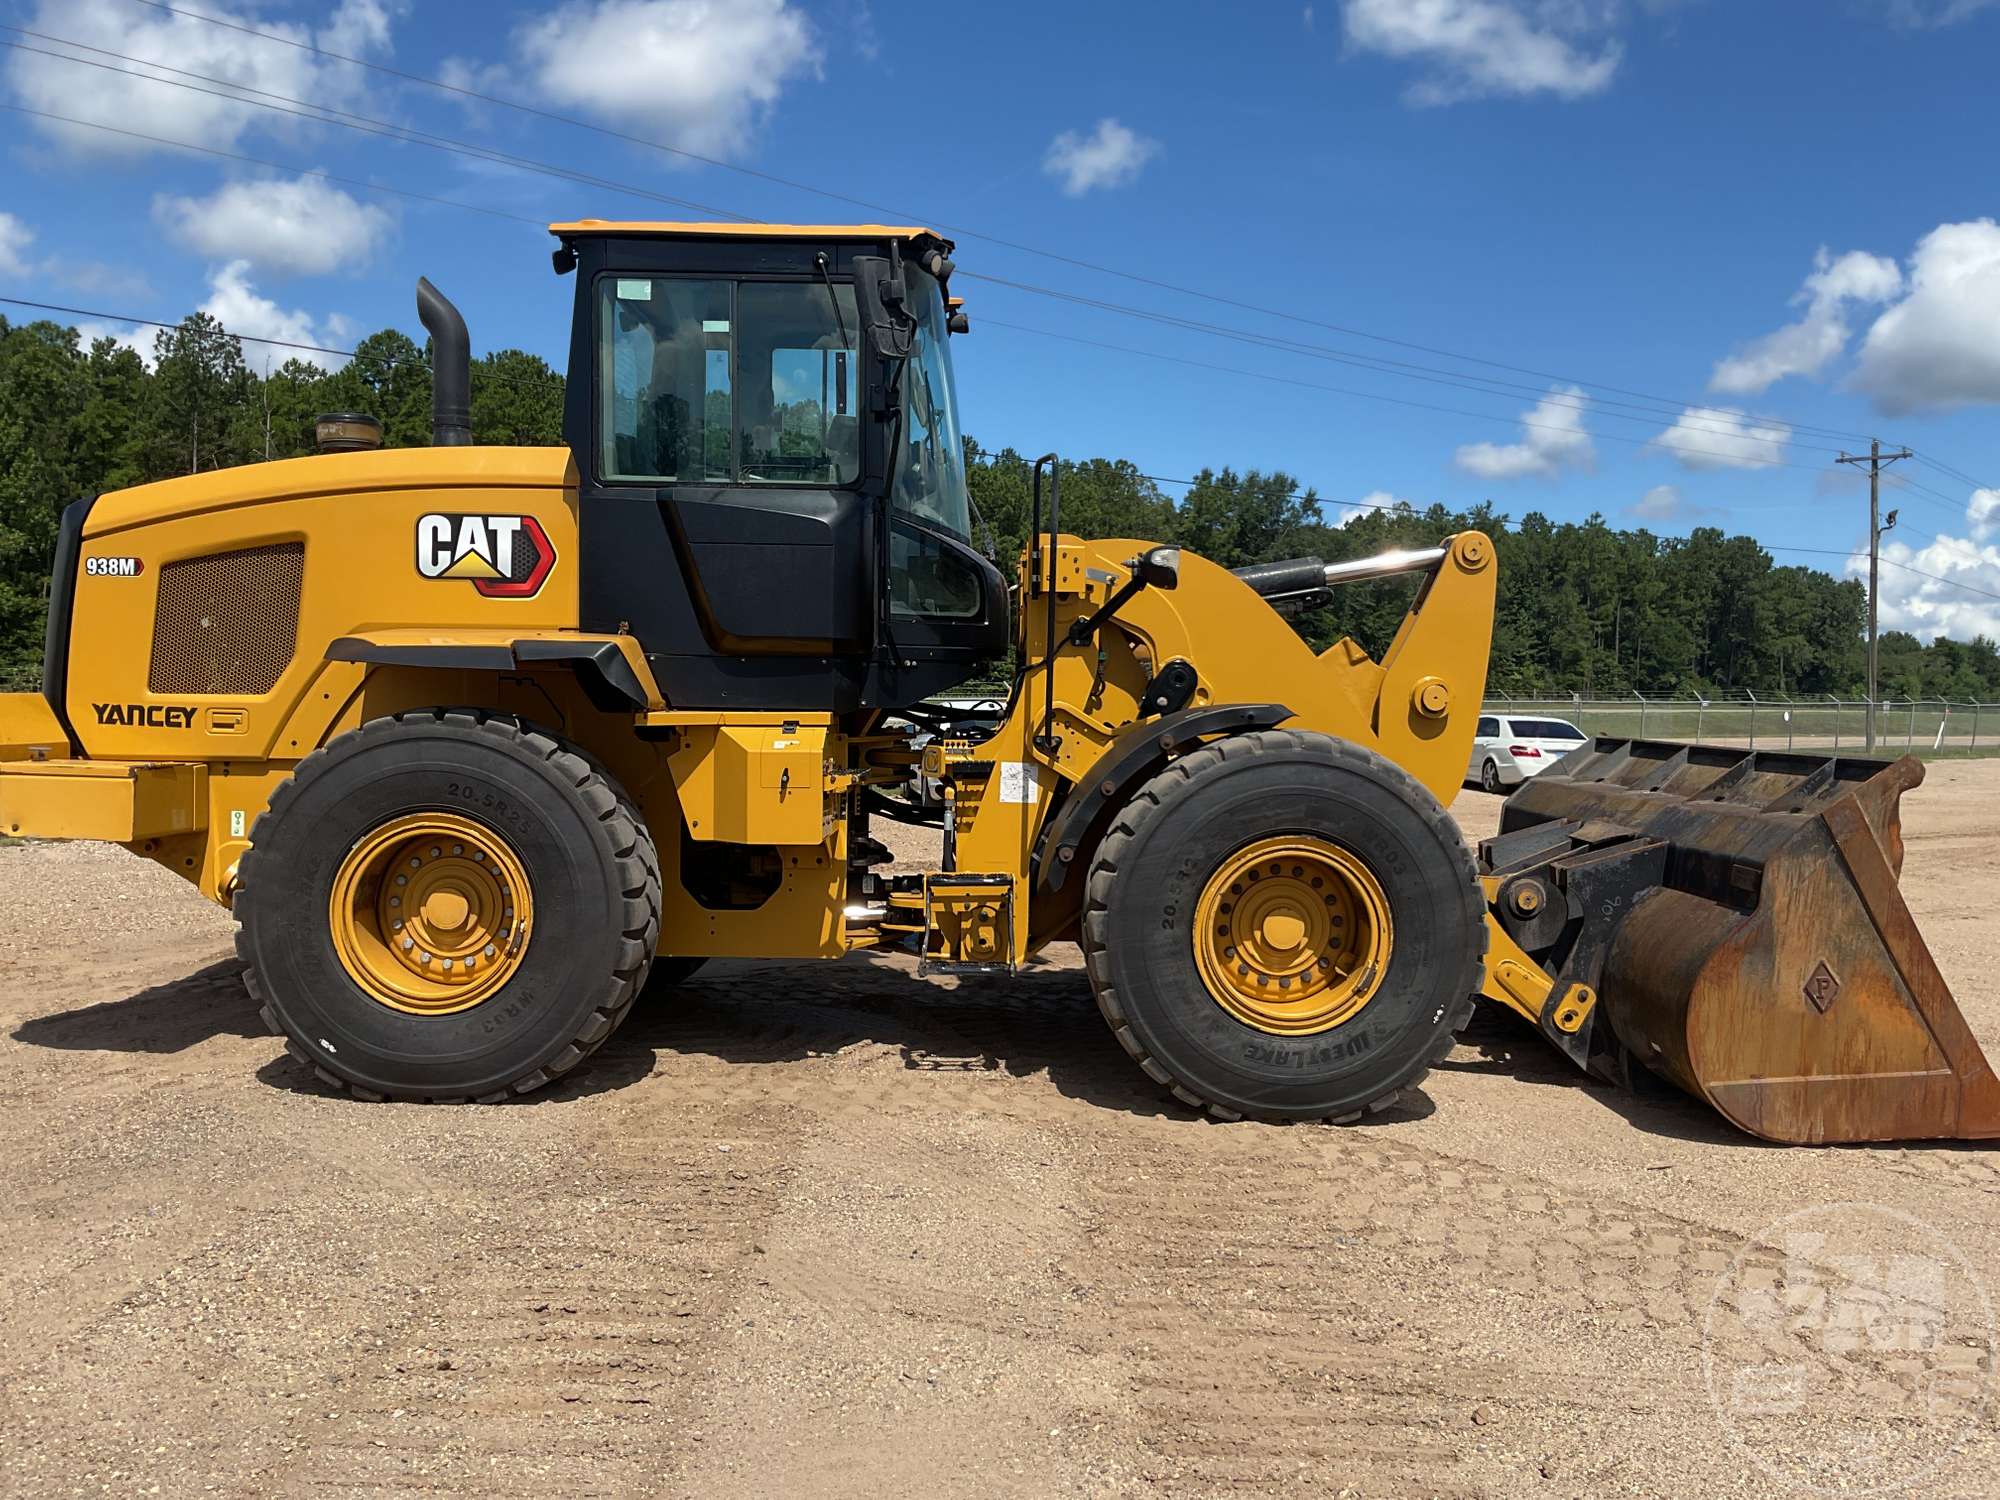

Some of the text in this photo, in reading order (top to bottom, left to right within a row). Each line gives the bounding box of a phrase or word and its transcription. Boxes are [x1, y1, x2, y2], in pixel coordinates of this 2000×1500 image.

[418, 514, 521, 578] CAT
[86, 557, 135, 577] 938M
[91, 703, 198, 729] YANCEY
[1244, 1030, 1371, 1069] WESTLAKE
